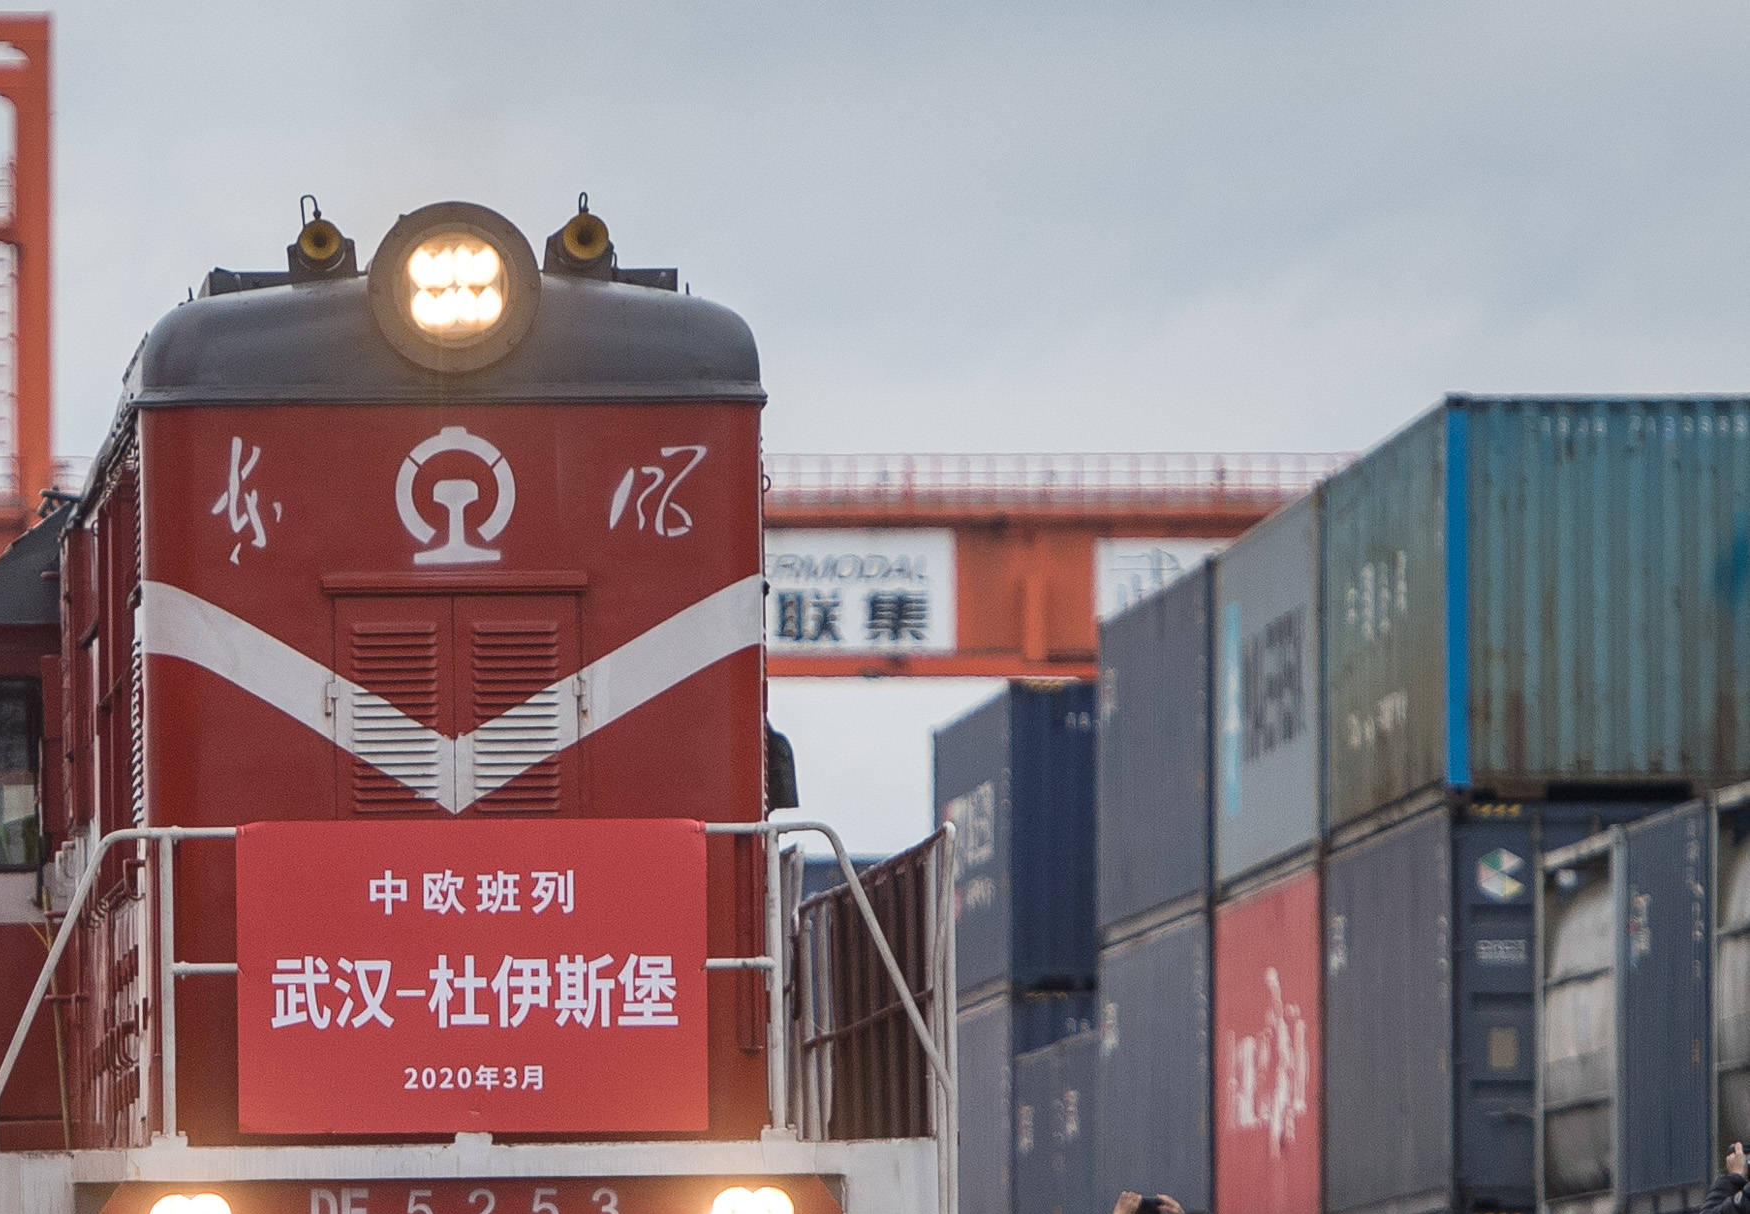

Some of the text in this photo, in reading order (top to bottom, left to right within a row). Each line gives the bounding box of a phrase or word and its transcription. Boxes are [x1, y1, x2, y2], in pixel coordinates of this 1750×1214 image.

[776, 587, 930, 641] 联集
[368, 869, 575, 915] 中欧班列
[270, 953, 680, 1030] 武汉-杜伊斯堡
[403, 1064, 545, 1091] 2020年3月
